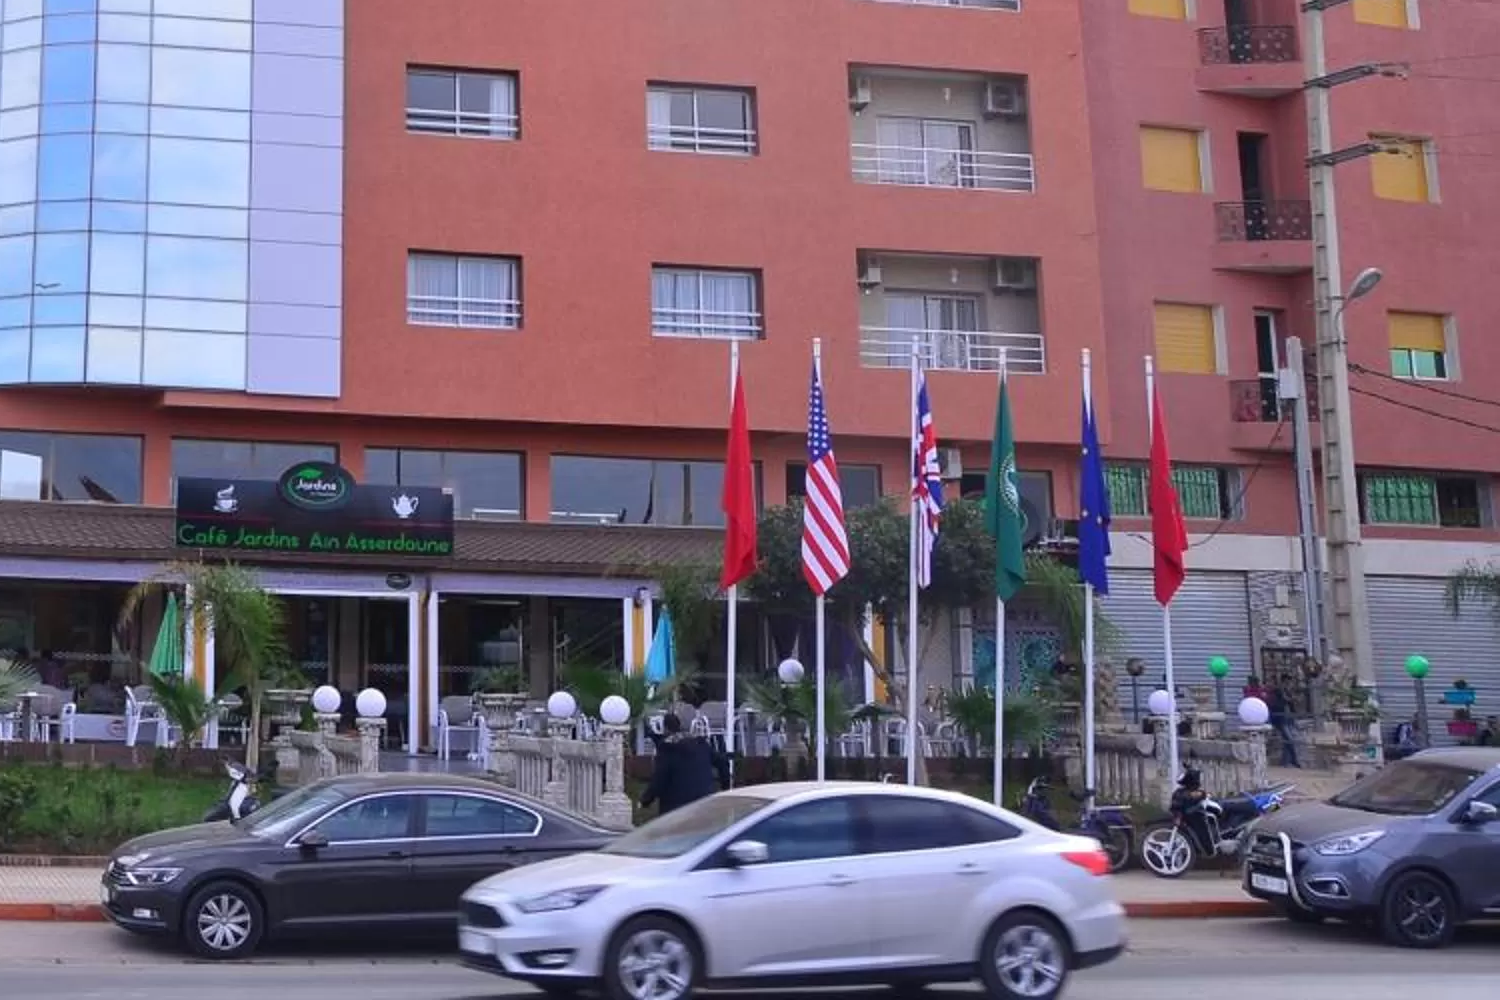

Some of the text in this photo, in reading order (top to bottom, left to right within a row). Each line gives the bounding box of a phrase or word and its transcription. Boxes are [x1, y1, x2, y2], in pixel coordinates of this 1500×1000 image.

[296, 478, 337, 491] Jardins
[179, 524, 449, 553] Café Jardins Ain Asserdoune
